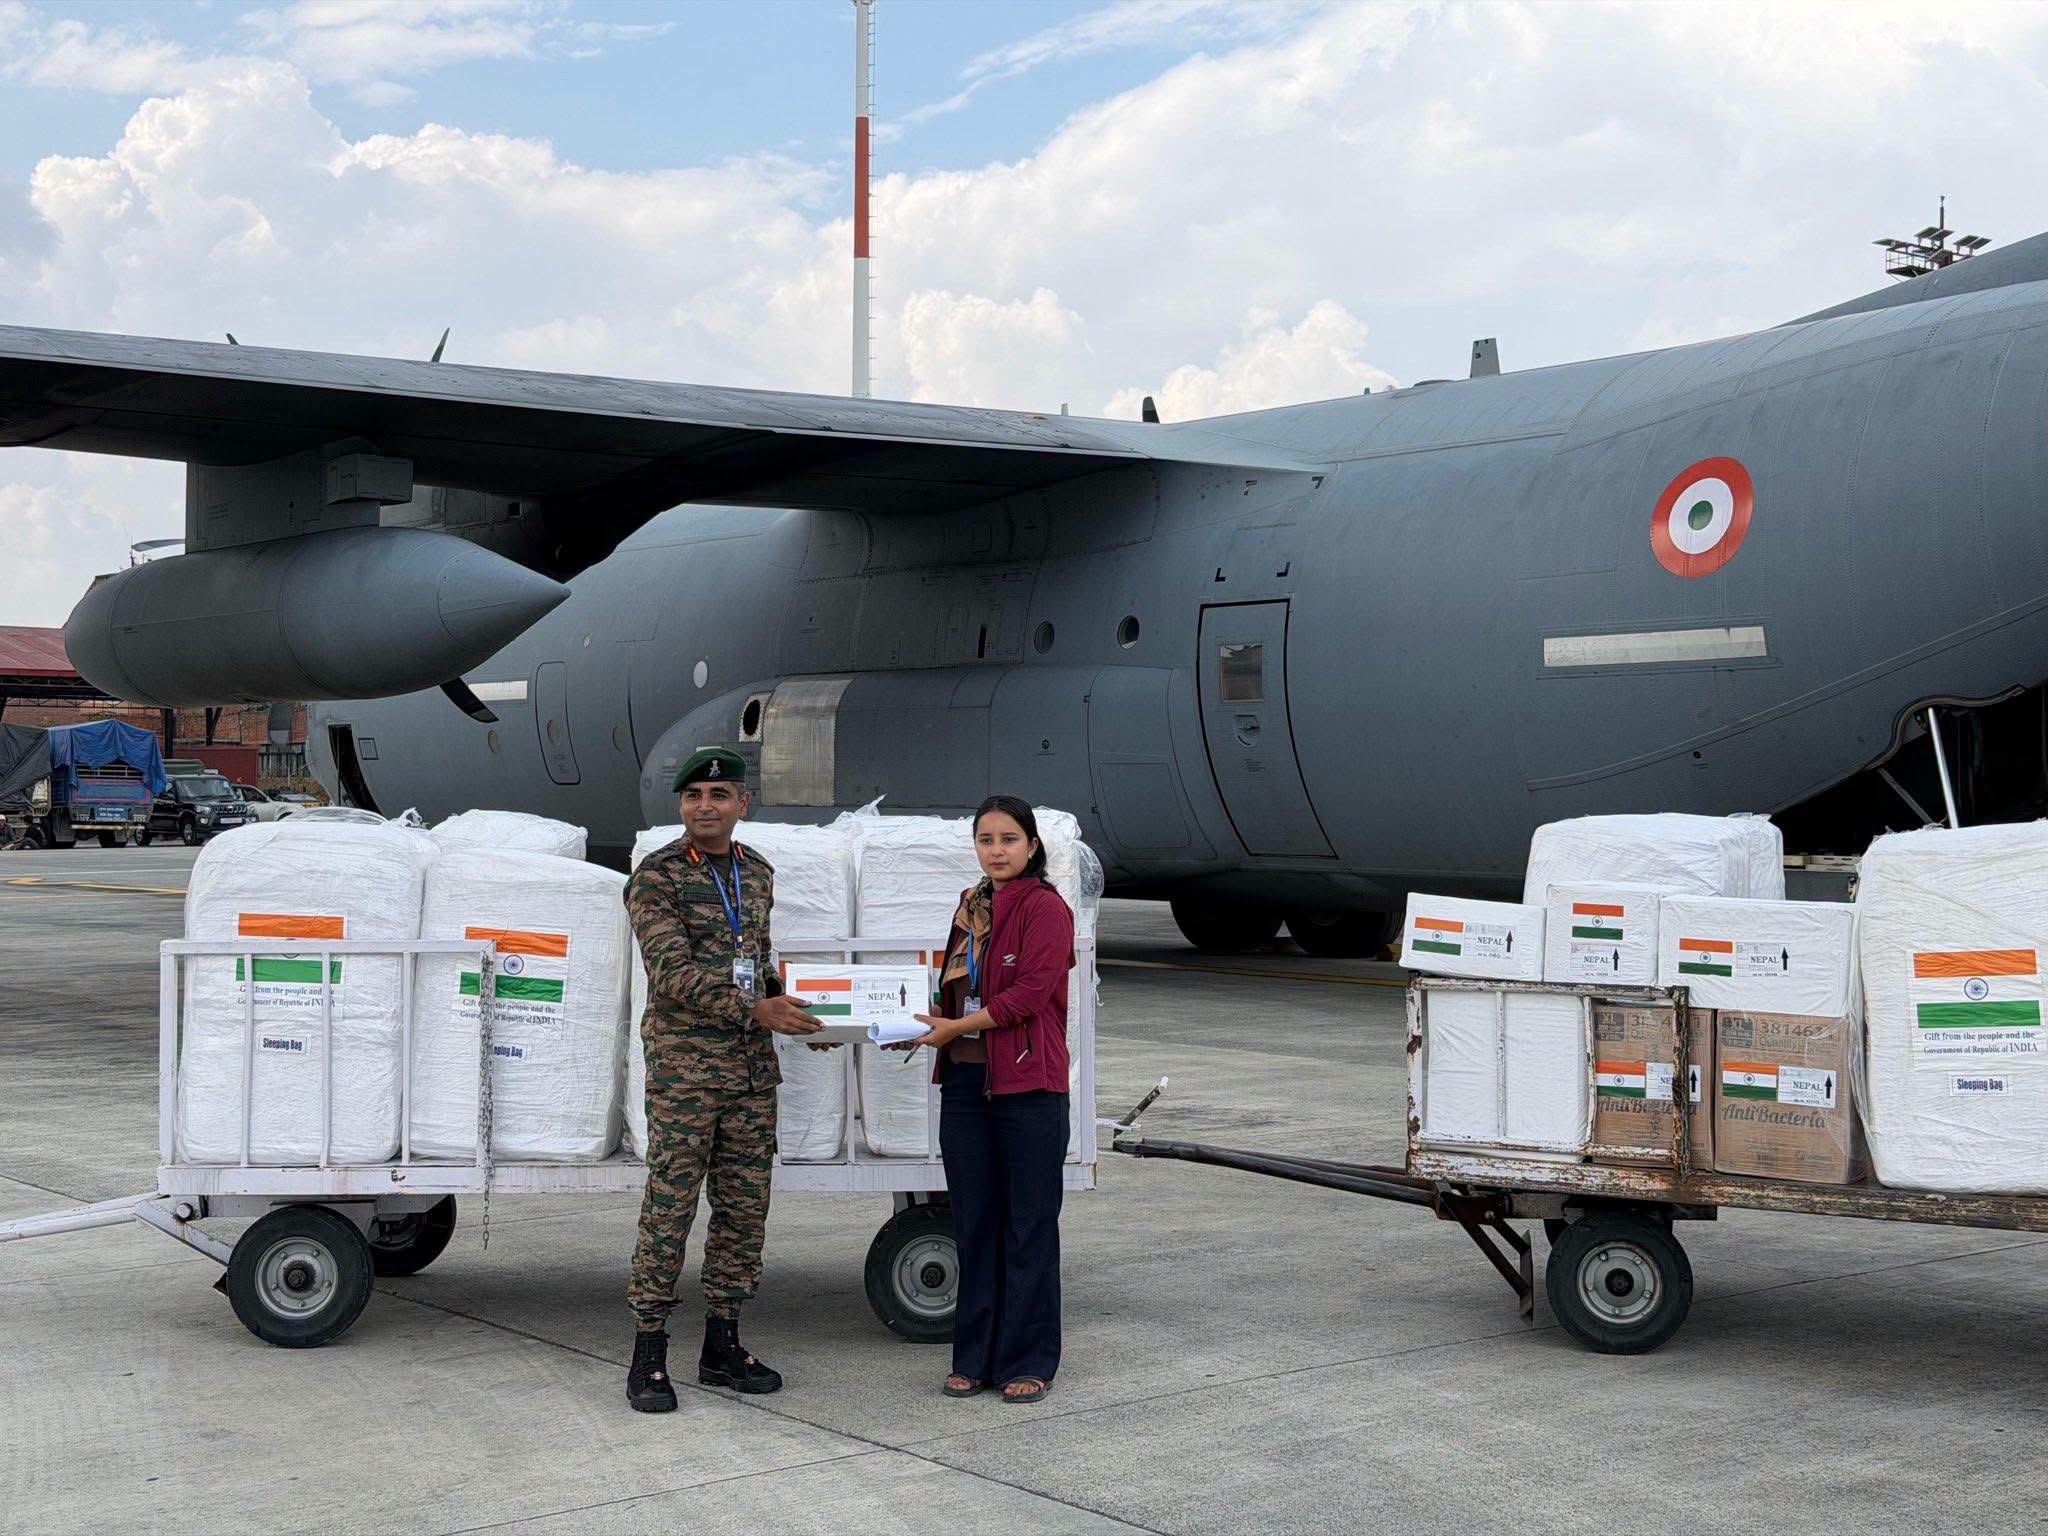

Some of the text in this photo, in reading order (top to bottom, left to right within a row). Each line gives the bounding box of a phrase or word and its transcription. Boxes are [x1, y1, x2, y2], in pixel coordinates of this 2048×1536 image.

[1477, 936, 1504, 946] NEPAL
[1583, 955, 1611, 964] NEPAL
[1750, 955, 1780, 964] NEPAL
[309, 986, 322, 995] and
[868, 992, 898, 1001] NEPAL
[462, 998, 476, 1007] Gift
[507, 1003, 529, 1012] people
[531, 1005, 544, 1013] and
[545, 1006, 556, 1014] the
[531, 1015, 556, 1025] INDIA
[1924, 1031, 2036, 1042] Gift from the people and the
[262, 1037, 303, 1051] Sleeping Bag
[1923, 1042, 2038, 1055] Government of Republic of INDIA
[511, 1046, 523, 1058] Bag
[1792, 1081, 1823, 1091] NEPAL
[1956, 1078, 2003, 1091] Sleeping Bag
[1721, 1103, 1826, 1128] AntiBacteria
